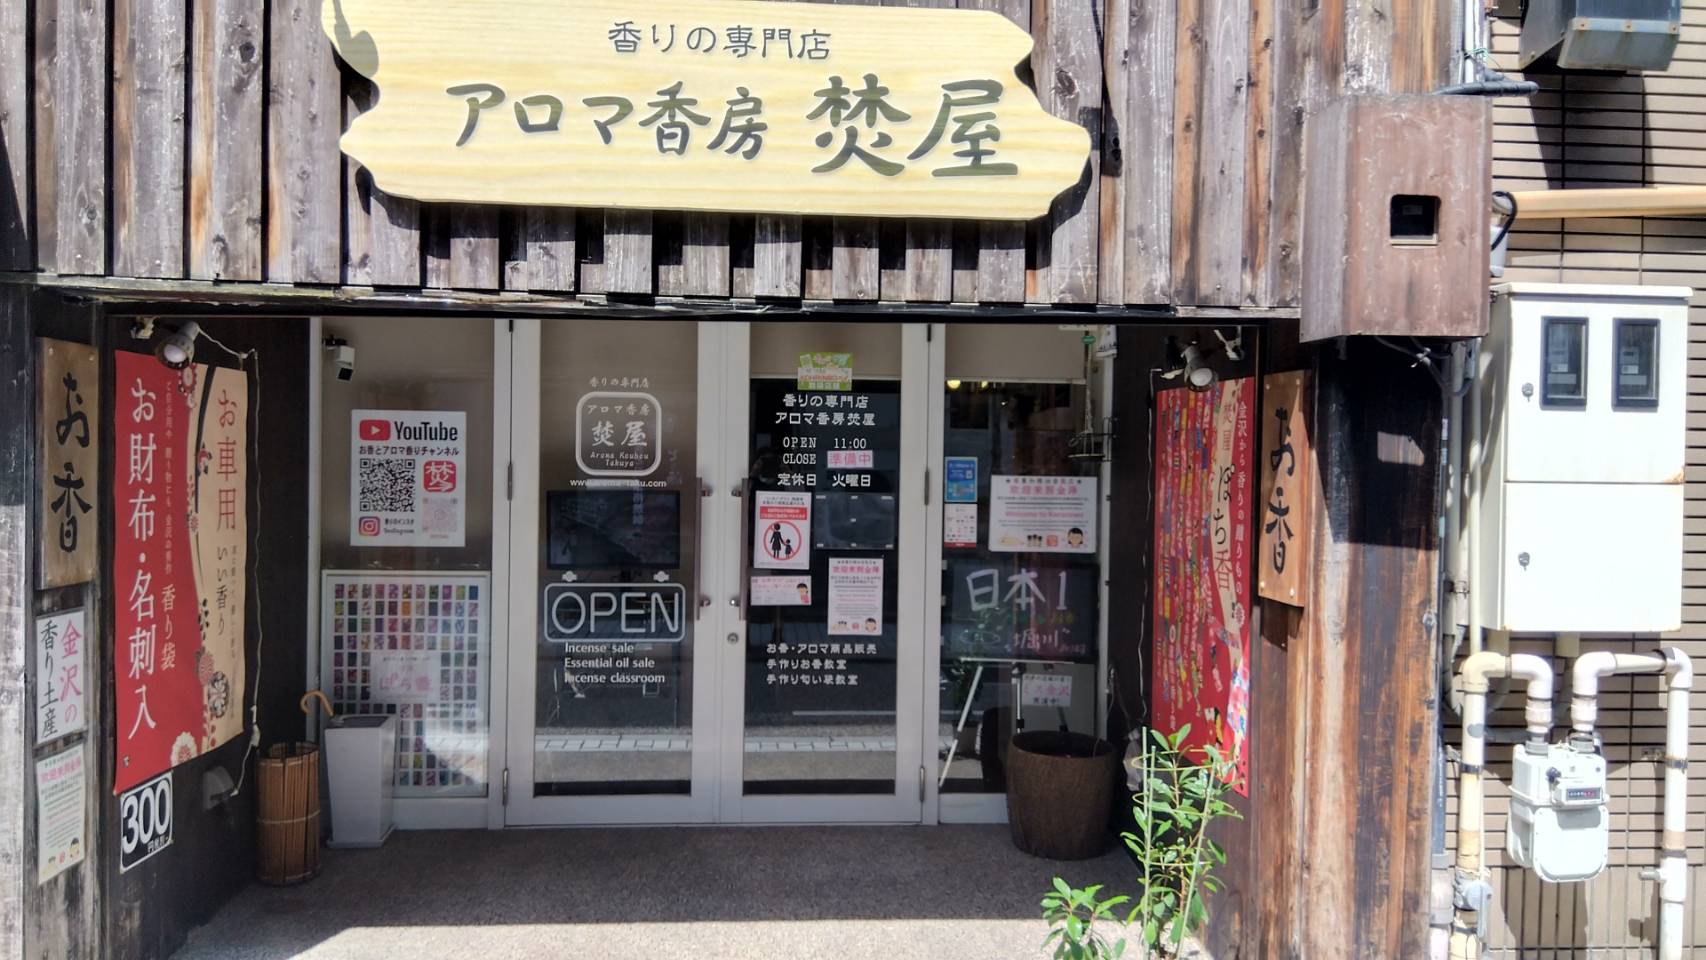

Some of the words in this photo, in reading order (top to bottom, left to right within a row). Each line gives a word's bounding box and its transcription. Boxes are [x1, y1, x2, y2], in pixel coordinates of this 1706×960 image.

[607, 20, 832, 61] 香りの専門店
[446, 80, 770, 161] アロマ香房
[805, 72, 1018, 178] 焚屋
[588, 376, 650, 388] 香りの専門店
[587, 403, 650, 416] アロマ香房
[783, 394, 869, 409] 香りの専門店
[775, 412, 876, 426] アロマ香房焚屋
[394, 421, 458, 441] YouTube
[591, 420, 648, 447] 焚屋
[783, 437, 817, 448] OPEN
[833, 438, 867, 449] 11:00
[51, 371, 93, 553] お香
[216, 388, 238, 531] お車用
[605, 459, 635, 468] Takuya
[782, 453, 817, 465] CLOSE
[777, 473, 817, 486] 定休日
[832, 473, 871, 487] 火曜日
[1266, 406, 1296, 575] お香
[128, 377, 157, 740] お財布・名刺入
[216, 546, 229, 636] いい香り
[551, 591, 679, 634] OPEN
[160, 583, 177, 671] 香り袋
[564, 643, 607, 654] Incense
[611, 643, 635, 654] sale
[766, 643, 878, 655] お香・アロマ商品販売
[59, 618, 83, 724] 金沢の
[564, 657, 613, 669] Essential
[615, 657, 630, 669] oil
[632, 657, 656, 669] sale
[766, 658, 848, 670] 手作りお香教室
[40, 619, 60, 739] 香り土産
[564, 672, 607, 684] Incense
[610, 672, 666, 684] classroom
[122, 779, 171, 854] 300
